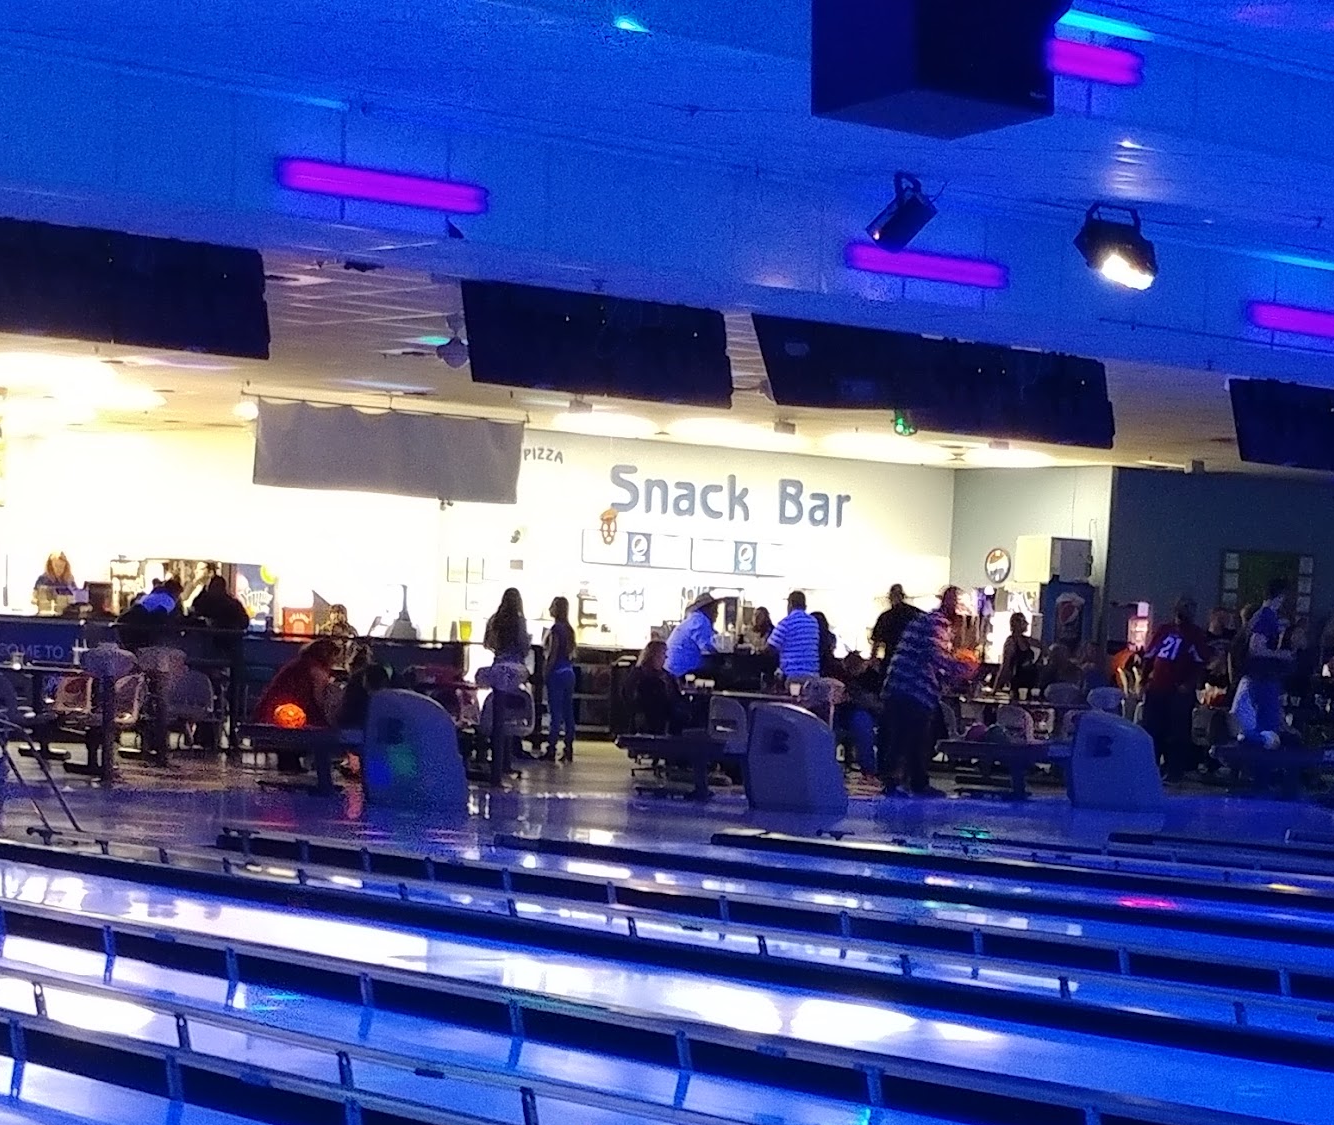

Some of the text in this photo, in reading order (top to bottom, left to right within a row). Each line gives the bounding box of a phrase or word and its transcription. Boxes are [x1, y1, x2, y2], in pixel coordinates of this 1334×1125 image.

[523, 447, 563, 464] PIZZA
[610, 464, 852, 528] Snack Bar
[1157, 634, 1183, 661] 21
